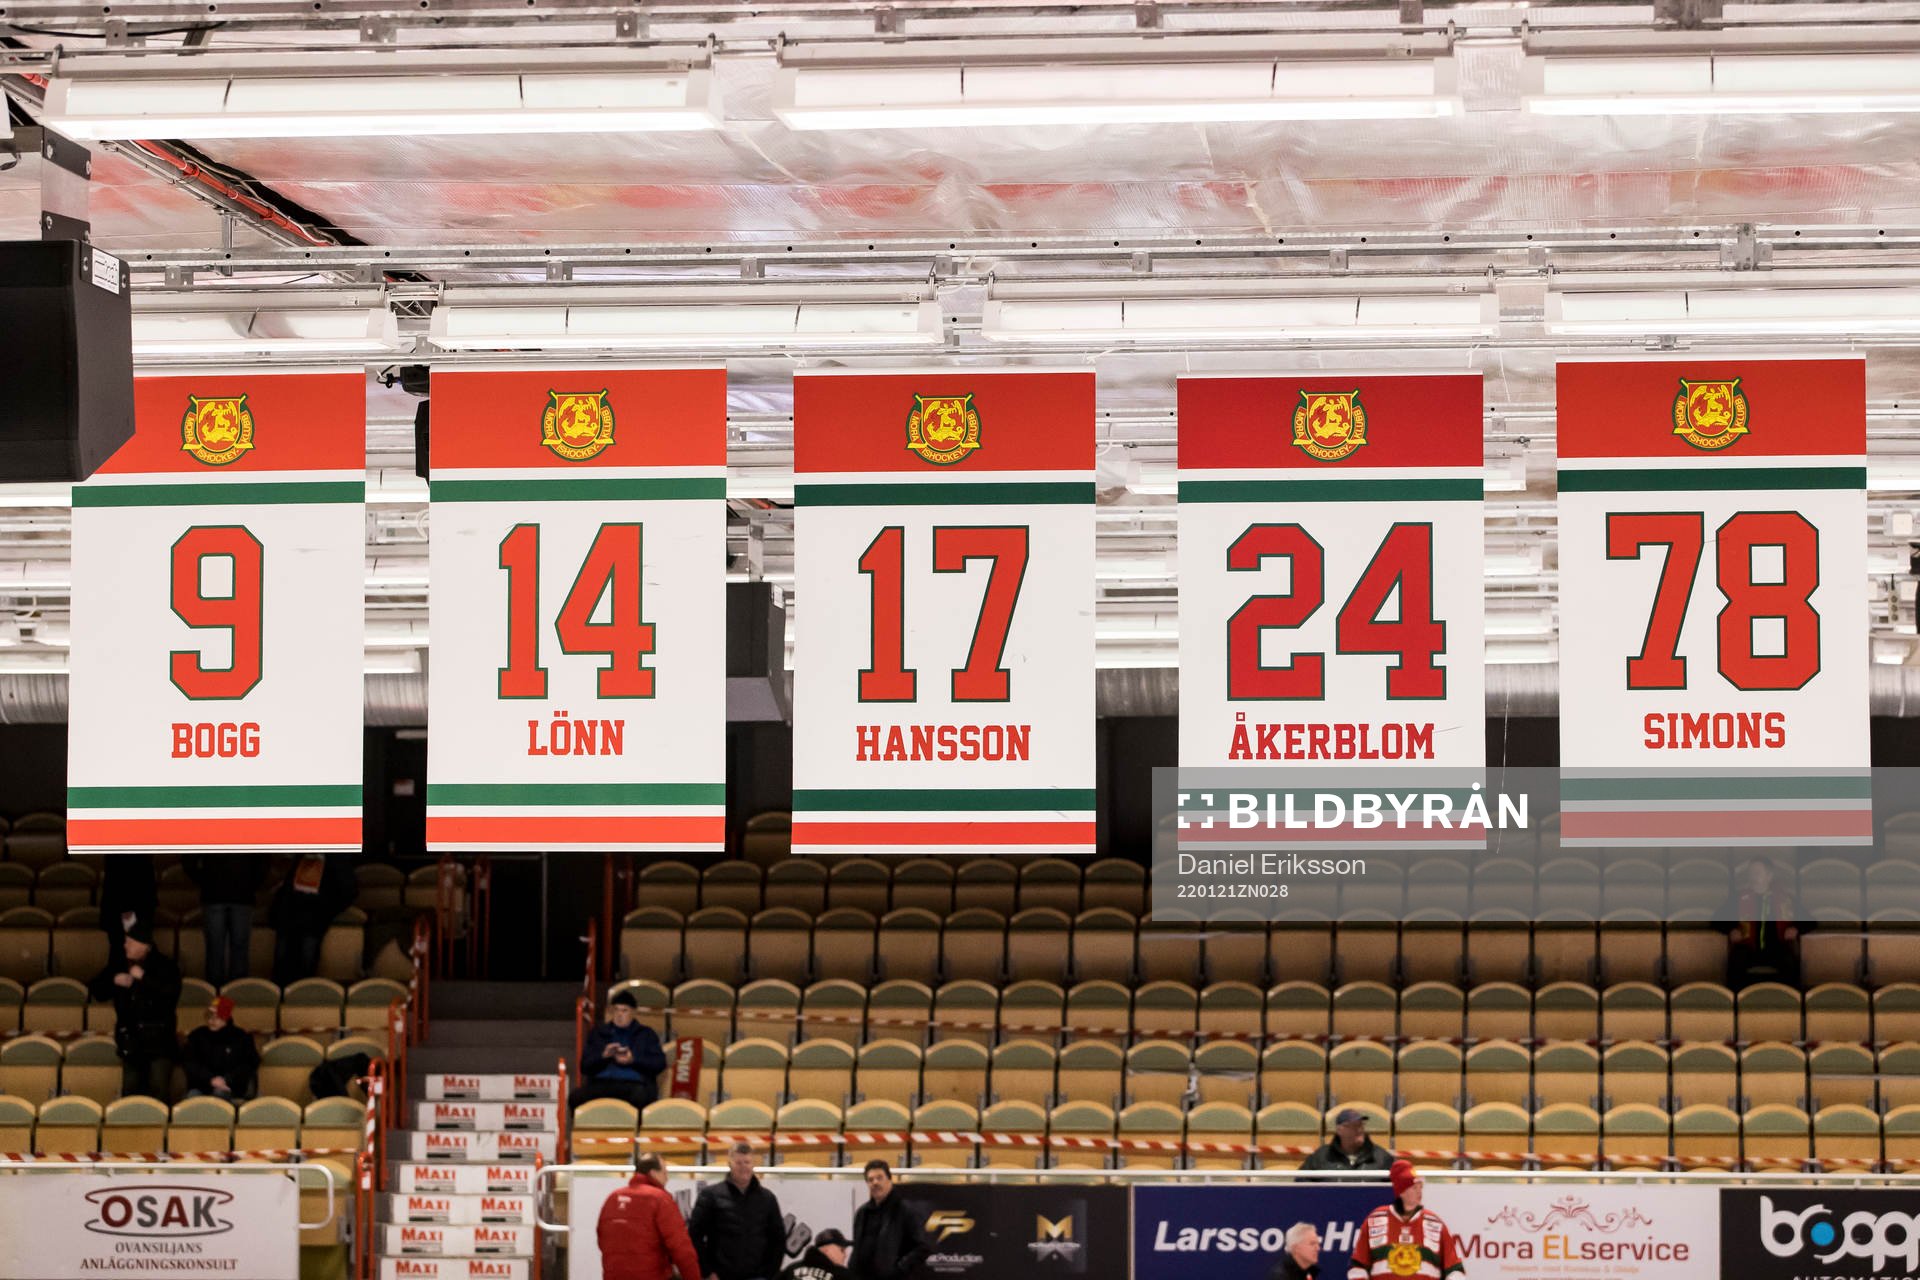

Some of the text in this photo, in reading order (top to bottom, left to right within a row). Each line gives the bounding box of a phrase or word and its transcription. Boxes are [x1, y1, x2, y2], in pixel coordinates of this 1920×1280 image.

[170, 525, 264, 700] 9
[498, 522, 656, 700] 14
[858, 525, 1030, 703] 17
[1227, 522, 1447, 701] 24
[1606, 511, 1822, 691] 78
[171, 723, 261, 759] BOGG
[528, 711, 624, 756] LÖNN
[857, 725, 1031, 761] HANSSON
[1229, 712, 1435, 760] ÅKERBLOM
[1644, 712, 1786, 748] SIMONS
[101, 1195, 217, 1228] OSAK
[80, 1256, 239, 1270] ANLÄGGNINGSKONSULT
[115, 1242, 203, 1255] OVANSILJANS
[1453, 1234, 1534, 1259] Mora
[1542, 1234, 1690, 1262] ELservice
